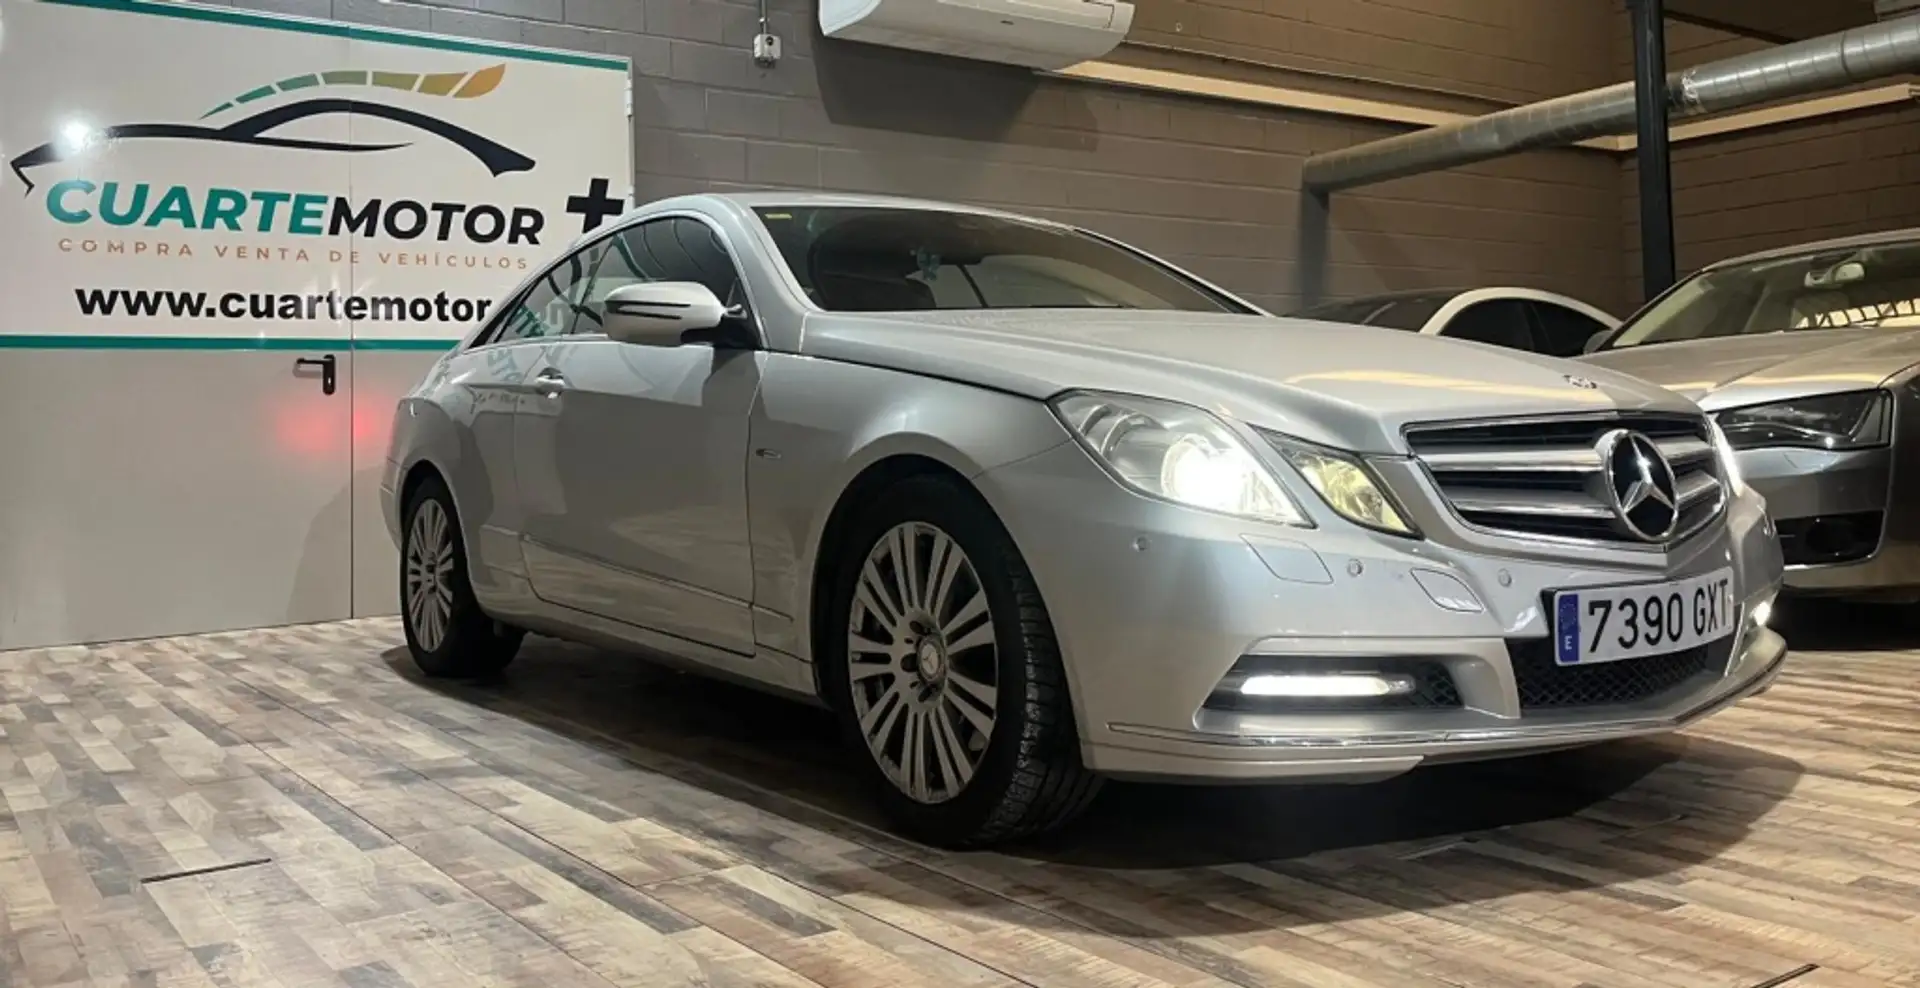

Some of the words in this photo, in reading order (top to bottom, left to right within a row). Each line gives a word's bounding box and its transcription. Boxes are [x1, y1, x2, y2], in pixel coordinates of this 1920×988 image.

[46, 179, 544, 245] CUARTEMOTOR
[58, 238, 193, 258] COMPRA
[214, 246, 310, 263] VENTA
[329, 250, 360, 265] DE
[379, 250, 529, 271] VEHÍCULOS
[76, 288, 492, 323] www.cuartemotor
[1588, 592, 1683, 653] 7390
[1693, 578, 1728, 636] GXT
[1564, 635, 1573, 650] E
